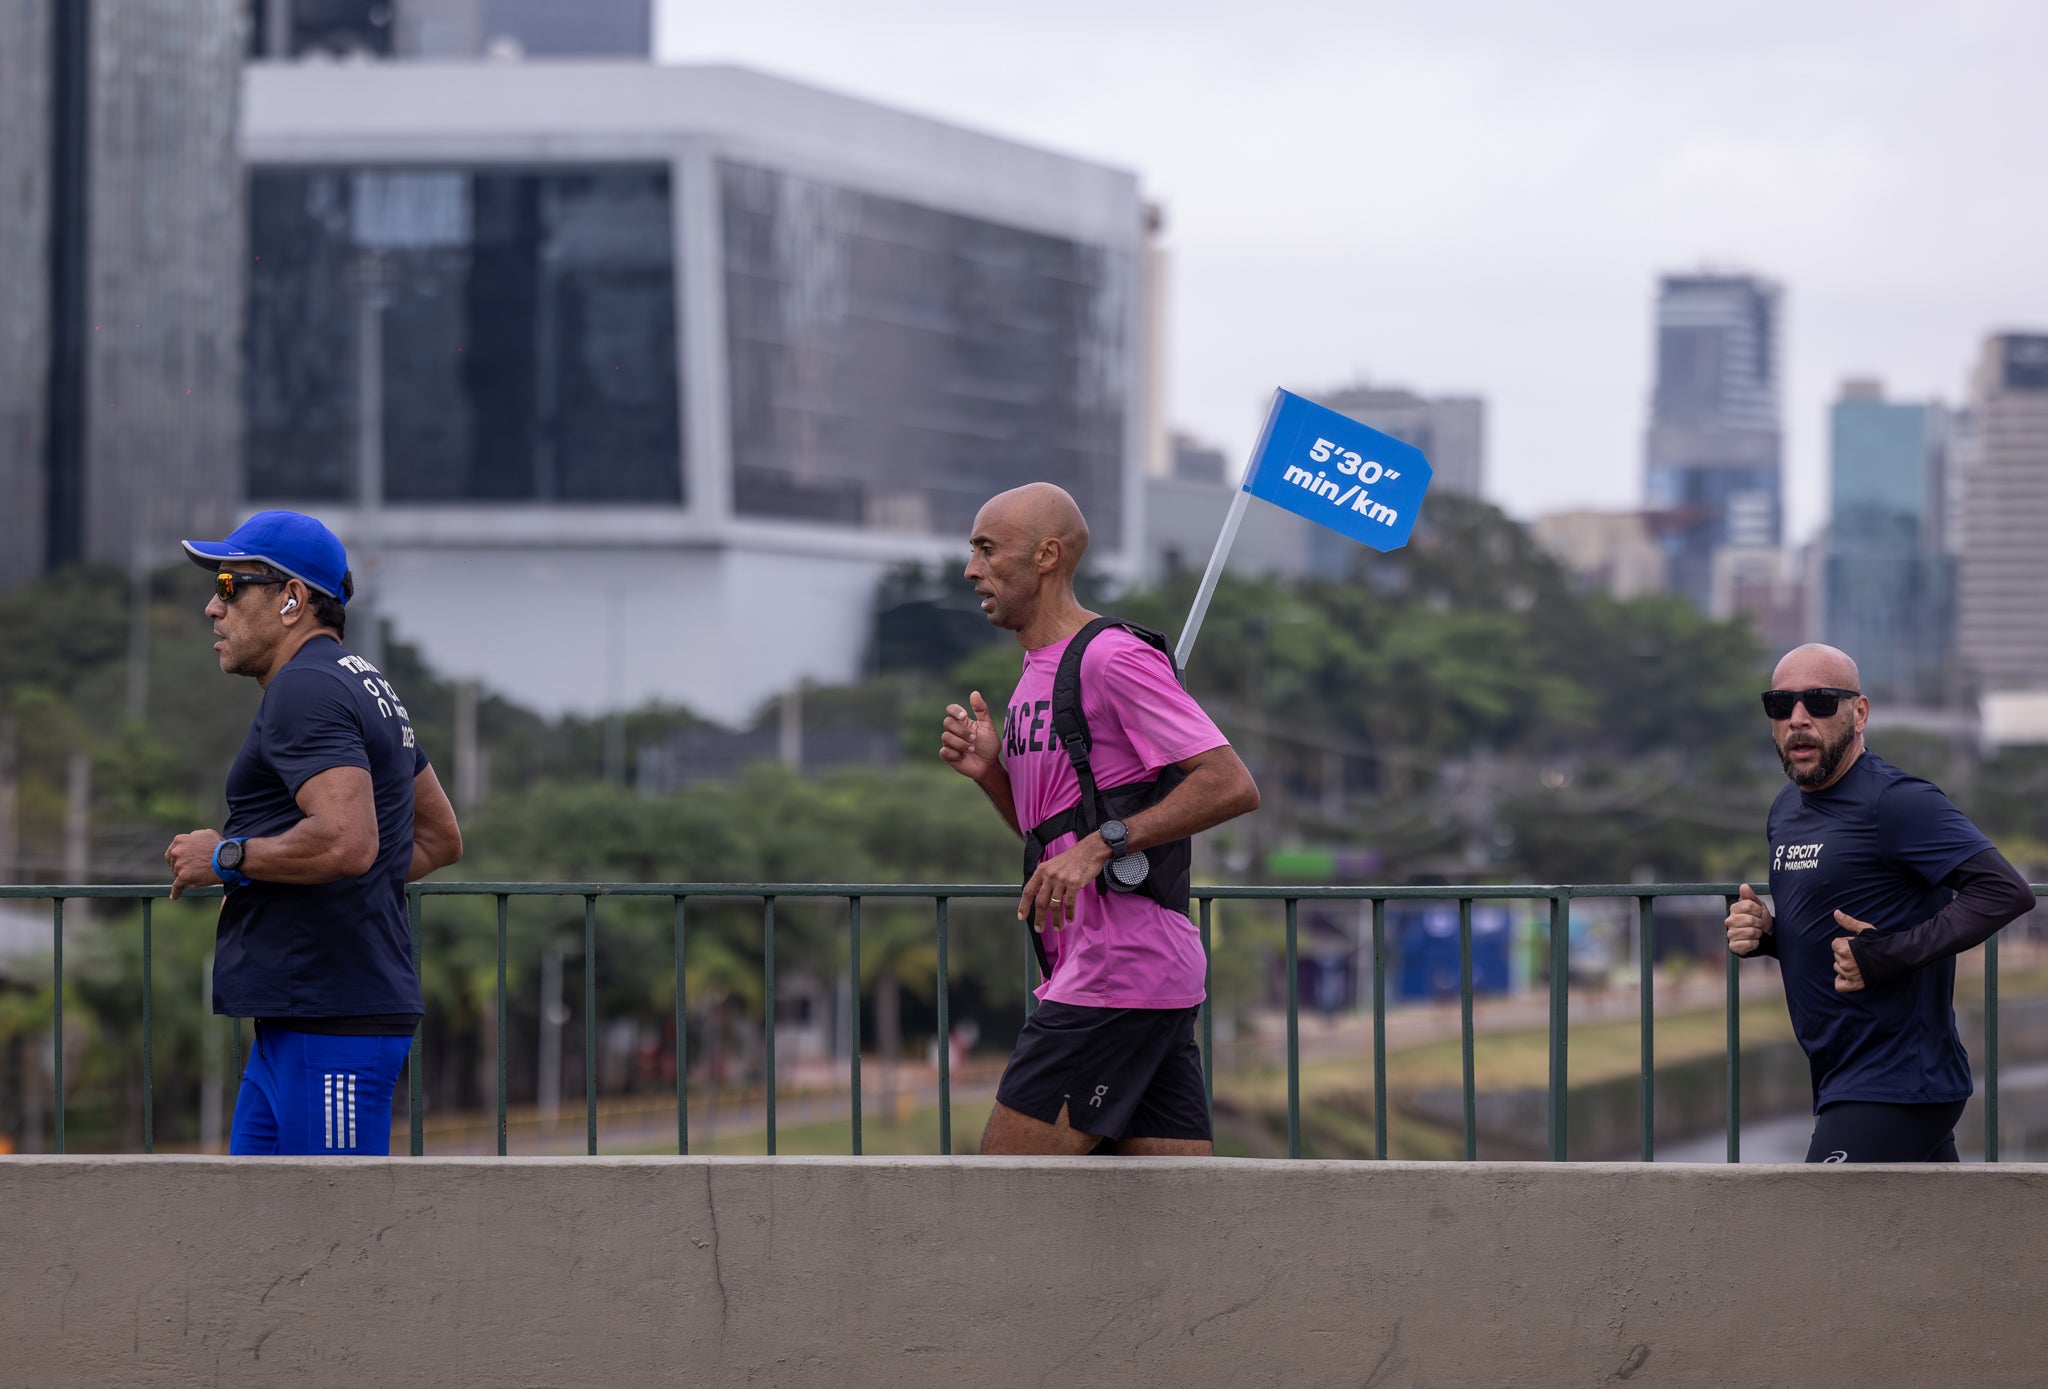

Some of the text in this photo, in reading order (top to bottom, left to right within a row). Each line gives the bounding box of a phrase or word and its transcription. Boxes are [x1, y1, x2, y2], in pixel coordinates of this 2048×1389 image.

[1282, 464, 1398, 527] min/km
[1786, 844, 1824, 859] SPCITY
[1785, 860, 1818, 870] MARATHON
